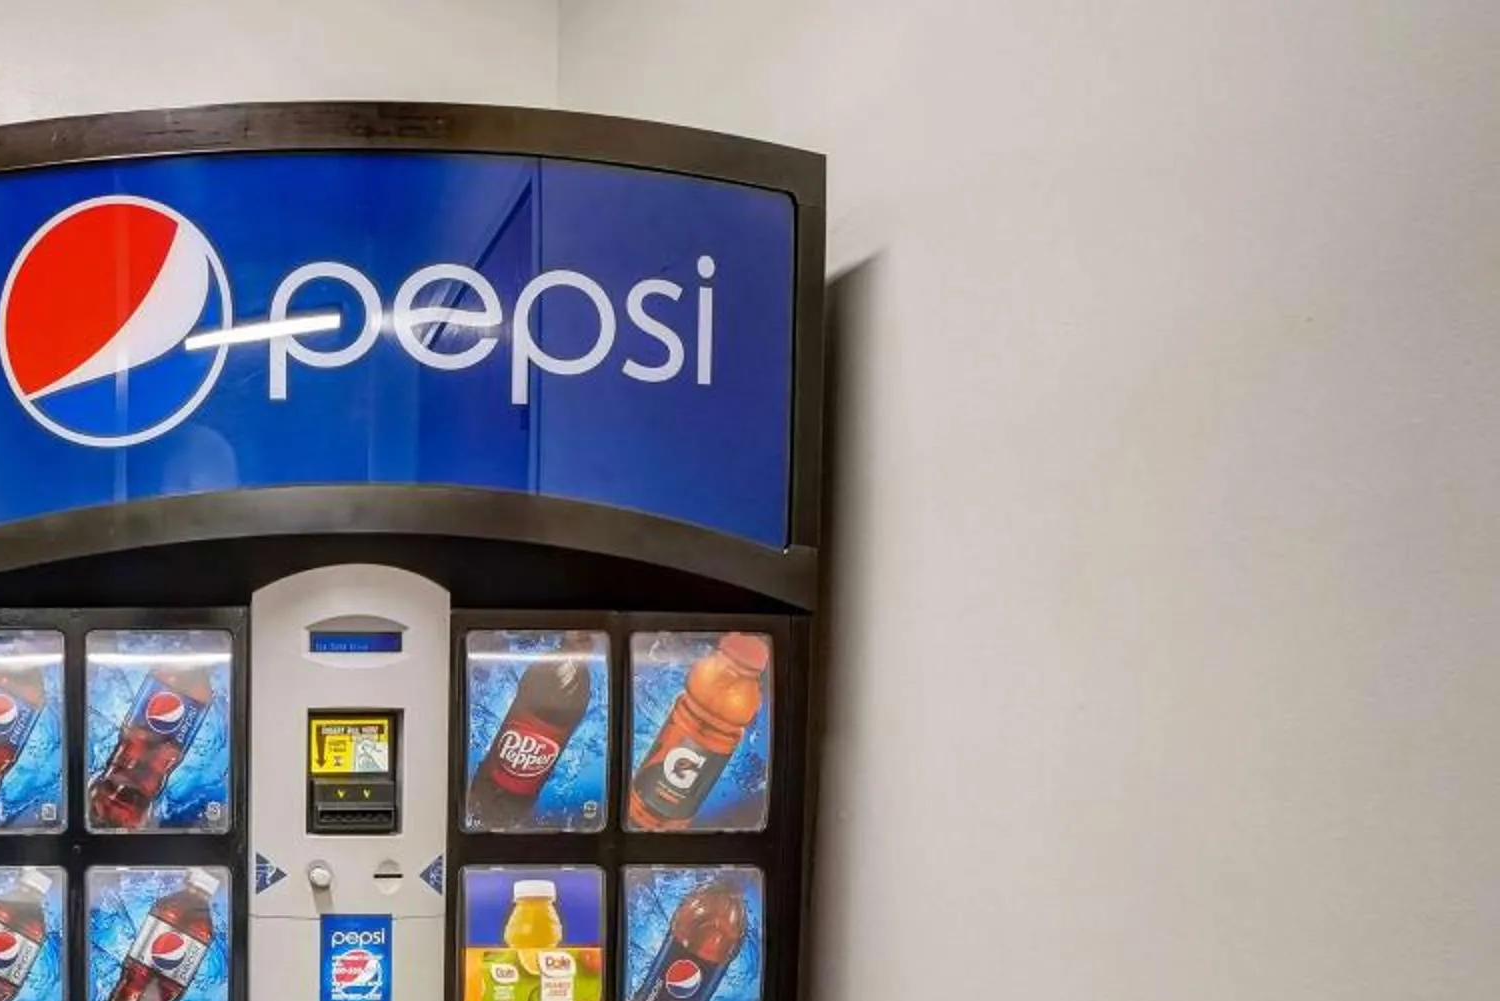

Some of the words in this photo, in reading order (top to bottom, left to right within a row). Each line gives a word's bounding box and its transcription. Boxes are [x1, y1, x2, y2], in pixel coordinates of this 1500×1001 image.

[268, 255, 717, 405] pepsi
[499, 730, 555, 770] Pepper
[520, 735, 547, 755] Dr
[663, 747, 707, 788] G
[331, 928, 386, 949] pepsi
